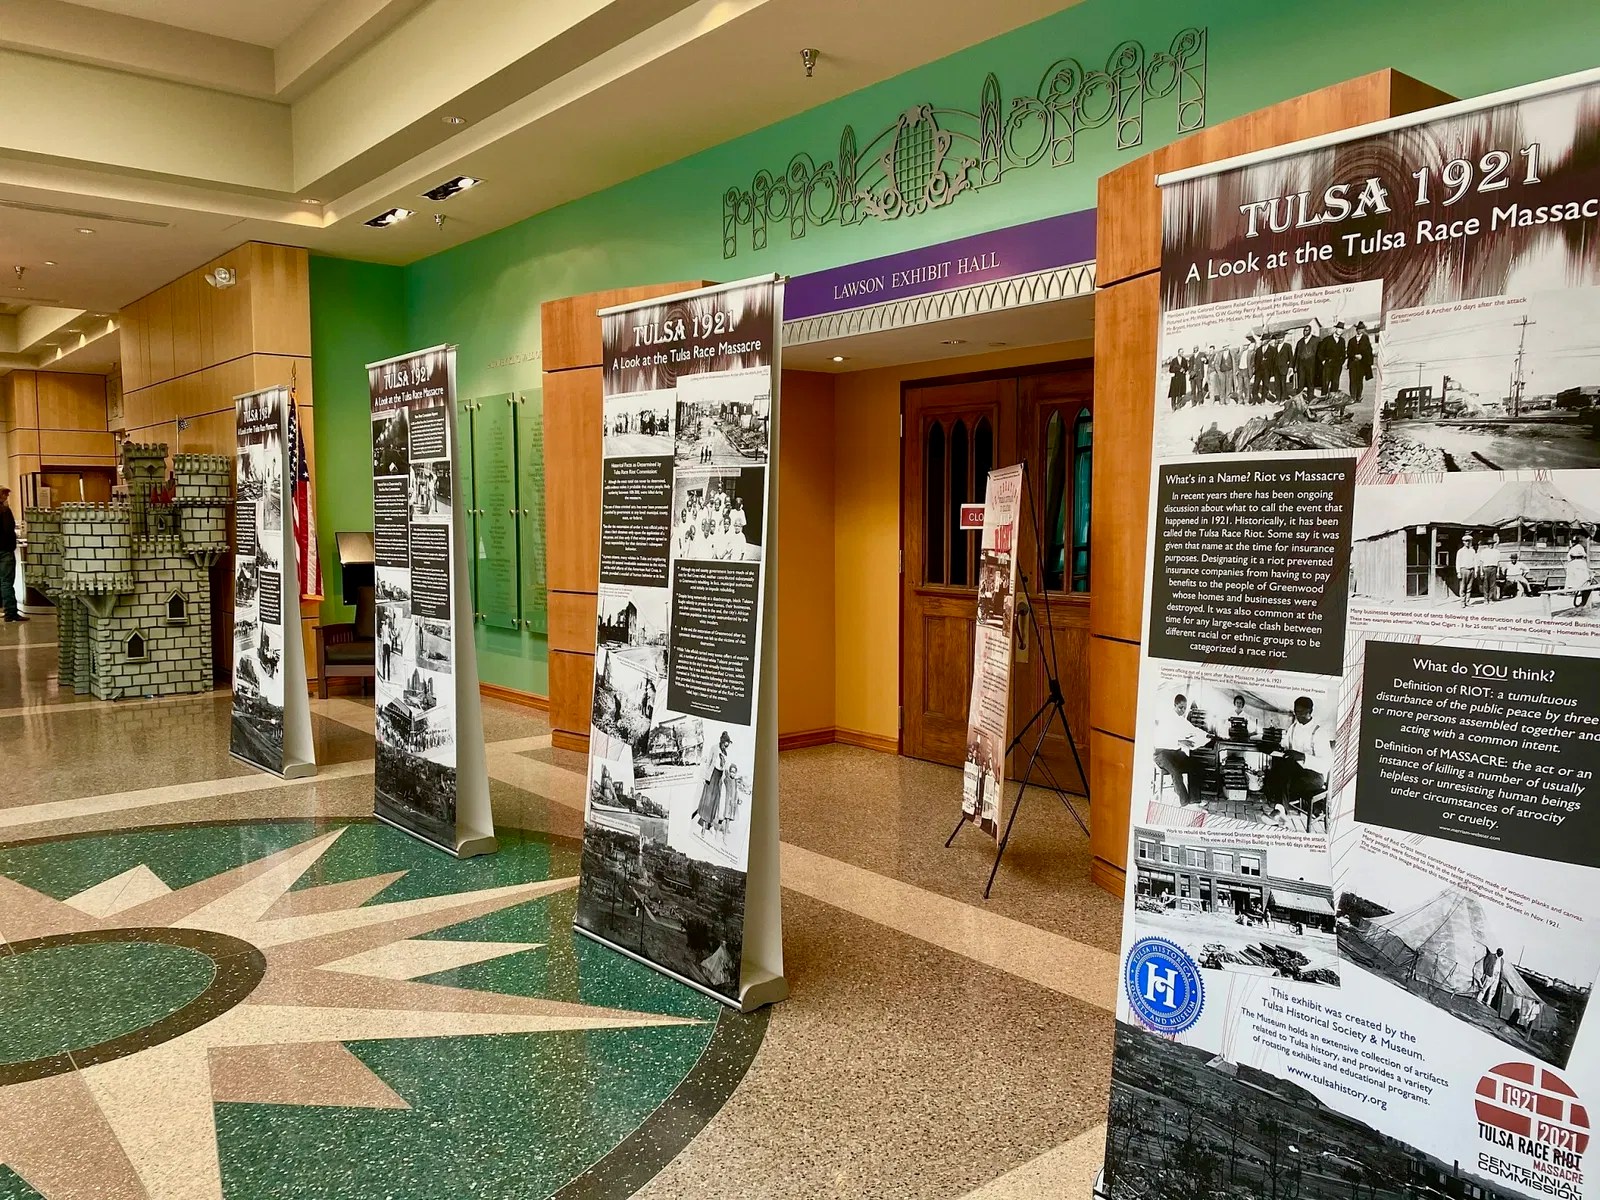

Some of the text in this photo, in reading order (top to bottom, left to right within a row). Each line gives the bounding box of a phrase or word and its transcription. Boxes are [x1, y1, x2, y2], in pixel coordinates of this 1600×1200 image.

[1239, 143, 1542, 239] TULSA 1921
[1185, 262, 1200, 284] A
[1207, 252, 1260, 280] Look
[1266, 250, 1288, 269] at
[1295, 242, 1333, 265] the
[1342, 228, 1406, 258] Tulsa
[1417, 215, 1480, 244] Race
[833, 252, 1001, 300] LAWSON EXHIBIT HALL
[633, 310, 735, 347] TULSA 1921
[1390, 310, 1424, 320] Greenwood
[612, 339, 761, 371] A Look at the Tulsa Race Massacre
[384, 366, 430, 390] TULSA 1921
[375, 398, 378, 407] A
[379, 397, 388, 406] Look
[389, 396, 393, 404] at
[402, 392, 412, 401] Tulsa
[412, 390, 423, 399] Race
[423, 387, 444, 398] Massacre
[1165, 470, 1345, 484] What's in a Name? Riot vs Massacre
[1163, 504, 1199, 512] discussion
[1200, 503, 1224, 512] about
[1225, 503, 1246, 512] what
[1248, 504, 1258, 512] to
[1261, 503, 1275, 512] call
[1278, 503, 1293, 512] the
[1324, 503, 1342, 512] that
[1171, 489, 1333, 502] In recent years there has been ongoing
[1165, 516, 1199, 527] happened
[1211, 516, 1232, 524] 1921.
[1234, 516, 1286, 527] Historically,
[1298, 517, 1314, 525] has
[1316, 517, 1338, 525] been
[1413, 658, 1555, 682] What do YOU think?
[1376, 691, 1599, 725] disturbance of the public peace by three
[1393, 678, 1442, 692] Definition
[1445, 684, 1458, 694] of
[1460, 685, 1493, 698] RIOT:
[1508, 692, 1577, 706] tumultuous
[1386, 708, 1413, 718] more
[1415, 712, 1457, 724] persons
[1459, 718, 1518, 731] assembled
[1521, 724, 1575, 738] together
[1400, 724, 1560, 753] acting with a common intent.
[1375, 738, 1592, 779] Definition of MASSACRE: the act or an
[1379, 754, 1585, 796] instance of killing a number of usually
[1380, 768, 1581, 811] helpless or unresisting human beings
[1390, 787, 1566, 825] under circumstances of atrocity
[1458, 814, 1498, 829] cruelty.
[1133, 945, 1194, 982] TULSA HISTORICAL
[1131, 981, 1196, 1025] SOCIETY AND MUSEUM
[1271, 986, 1416, 1043] This exhibit was created by the
[1261, 997, 1425, 1061] Tulsa Historical Society & Museum.
[1287, 1065, 1387, 1111] www.tulsahistory.org
[1505, 1086, 1538, 1113] 1921
[1478, 1122, 1582, 1171] TULSA RACE RIOT
[1540, 1124, 1578, 1152] 2021
[1478, 1161, 1582, 1200] COMMISSION
[1479, 1152, 1582, 1195] CENTENNIAL
[1533, 1160, 1584, 1185] MASSACRE
